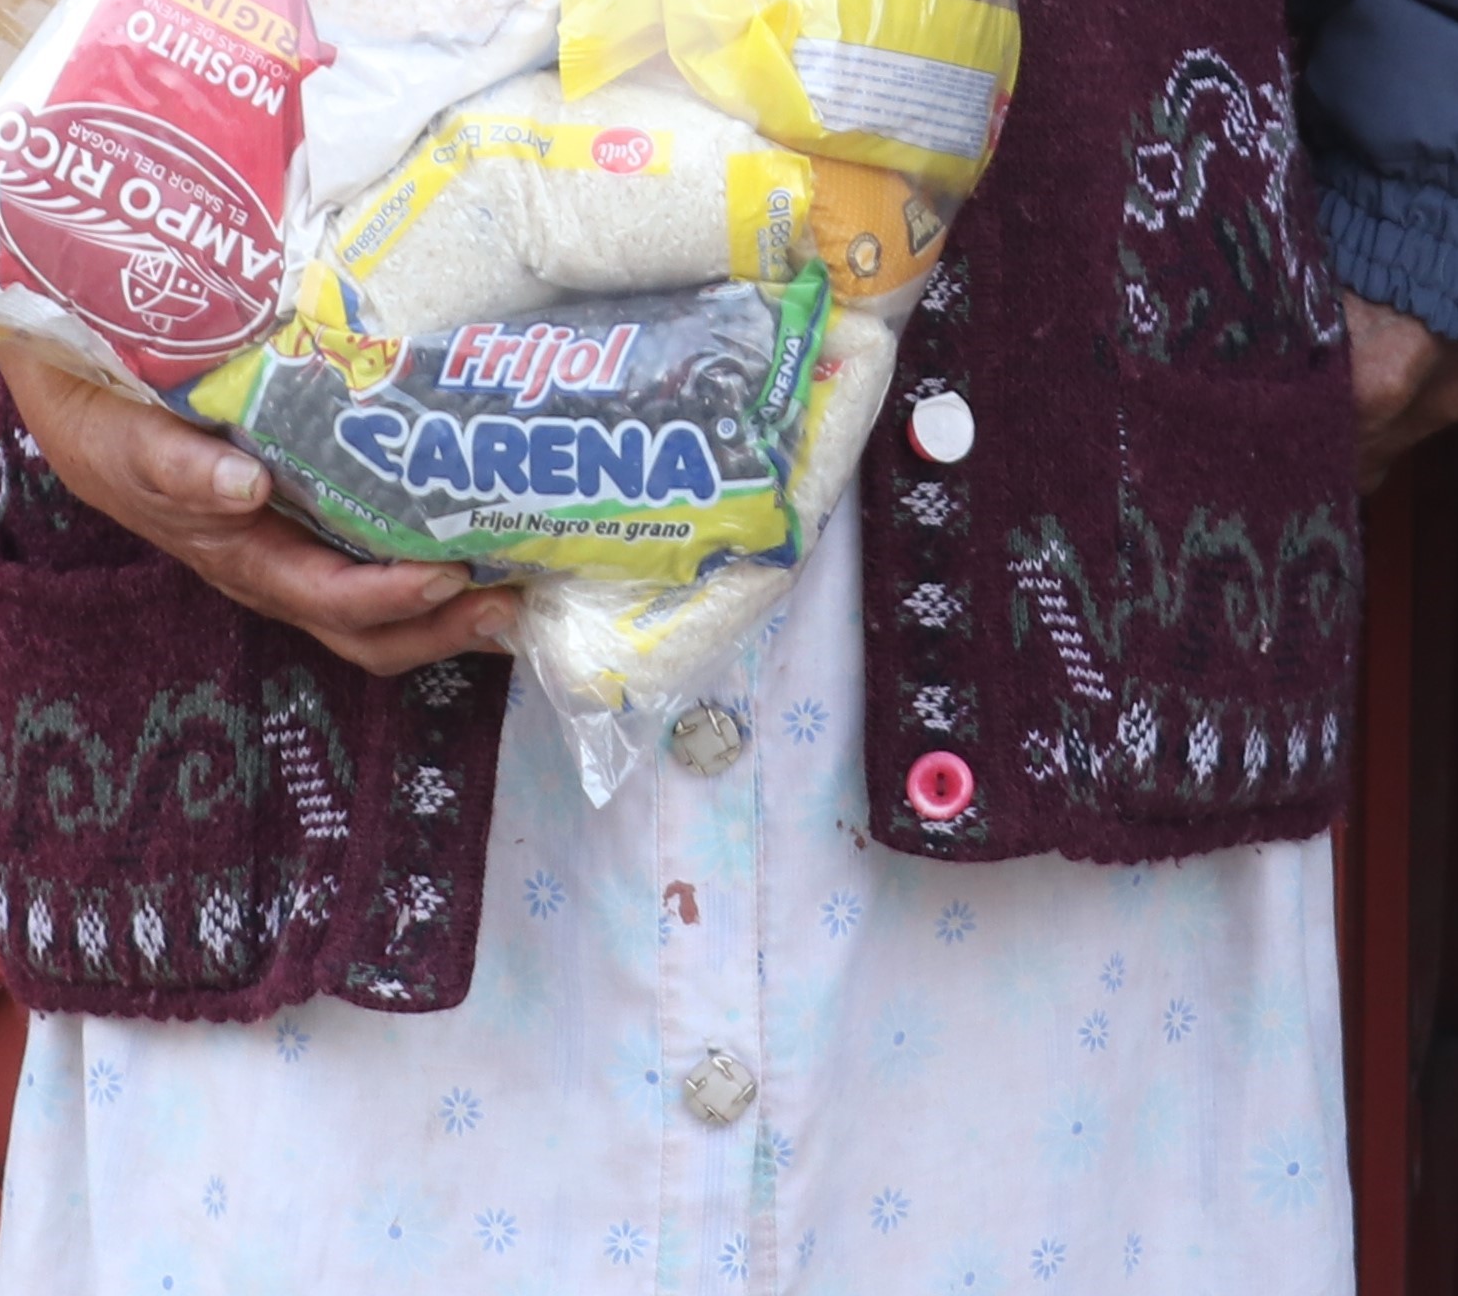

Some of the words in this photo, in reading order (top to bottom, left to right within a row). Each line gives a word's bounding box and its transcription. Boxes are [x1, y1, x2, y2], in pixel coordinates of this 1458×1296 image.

[193, 17, 216, 40] DE
[126, 9, 286, 117] MOSHITO
[218, 34, 292, 82] HOJUELAS
[67, 120, 131, 163] HOGAR
[596, 136, 649, 167] Suli
[132, 150, 167, 182] DEL
[167, 169, 225, 215] SABOR
[228, 202, 250, 228] EL
[440, 322, 640, 409] Frijol
[759, 336, 802, 421] ARENA
[468, 509, 523, 533] Frijol
[526, 512, 591, 538] Negro
[594, 520, 620, 536] en
[623, 521, 691, 542] grano
